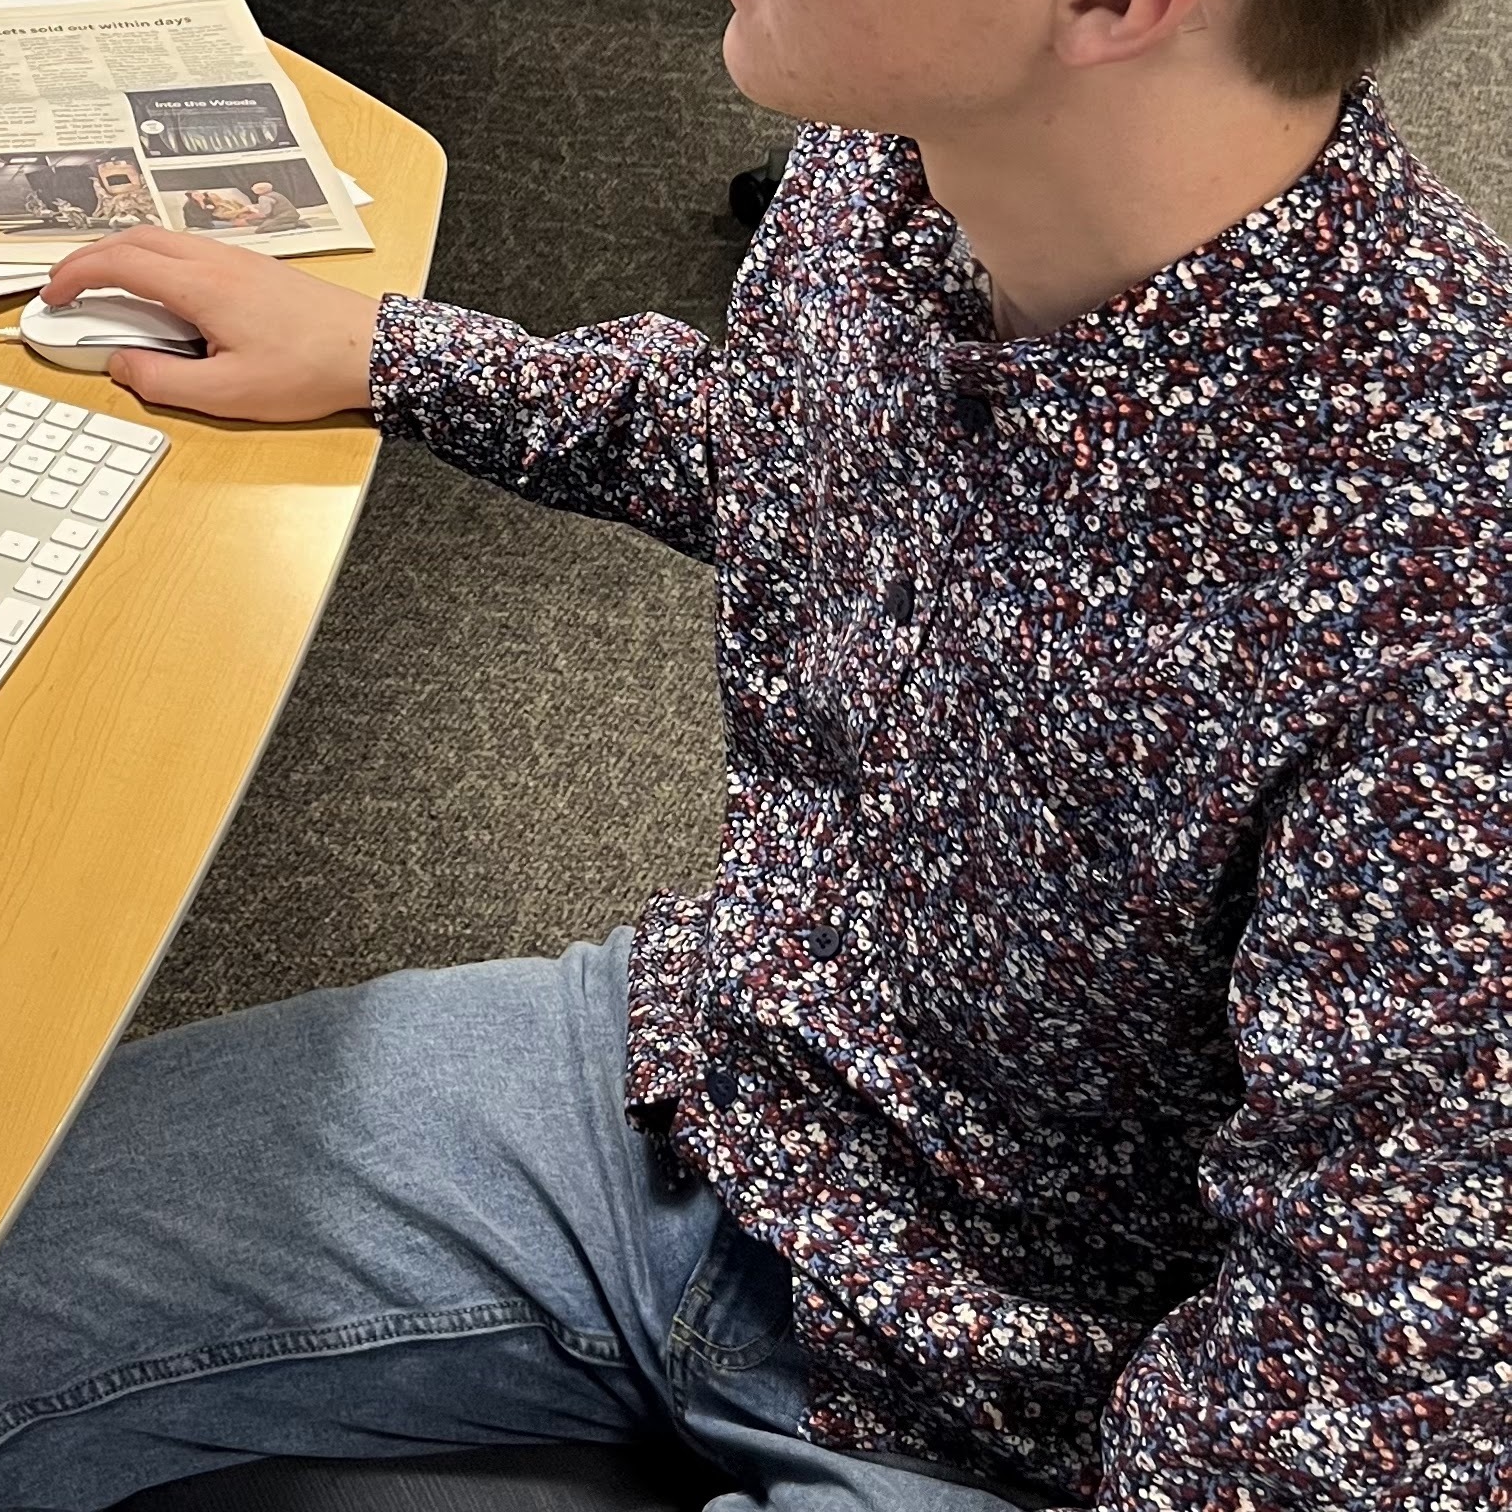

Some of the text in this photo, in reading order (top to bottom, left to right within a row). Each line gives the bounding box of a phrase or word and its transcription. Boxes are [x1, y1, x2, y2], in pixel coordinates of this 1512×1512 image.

[29, 24, 65, 36] sold
[67, 22, 96, 33] out
[97, 18, 152, 32] within
[154, 14, 193, 29] days
[154, 101, 182, 109] Into
[183, 99, 208, 108] the
